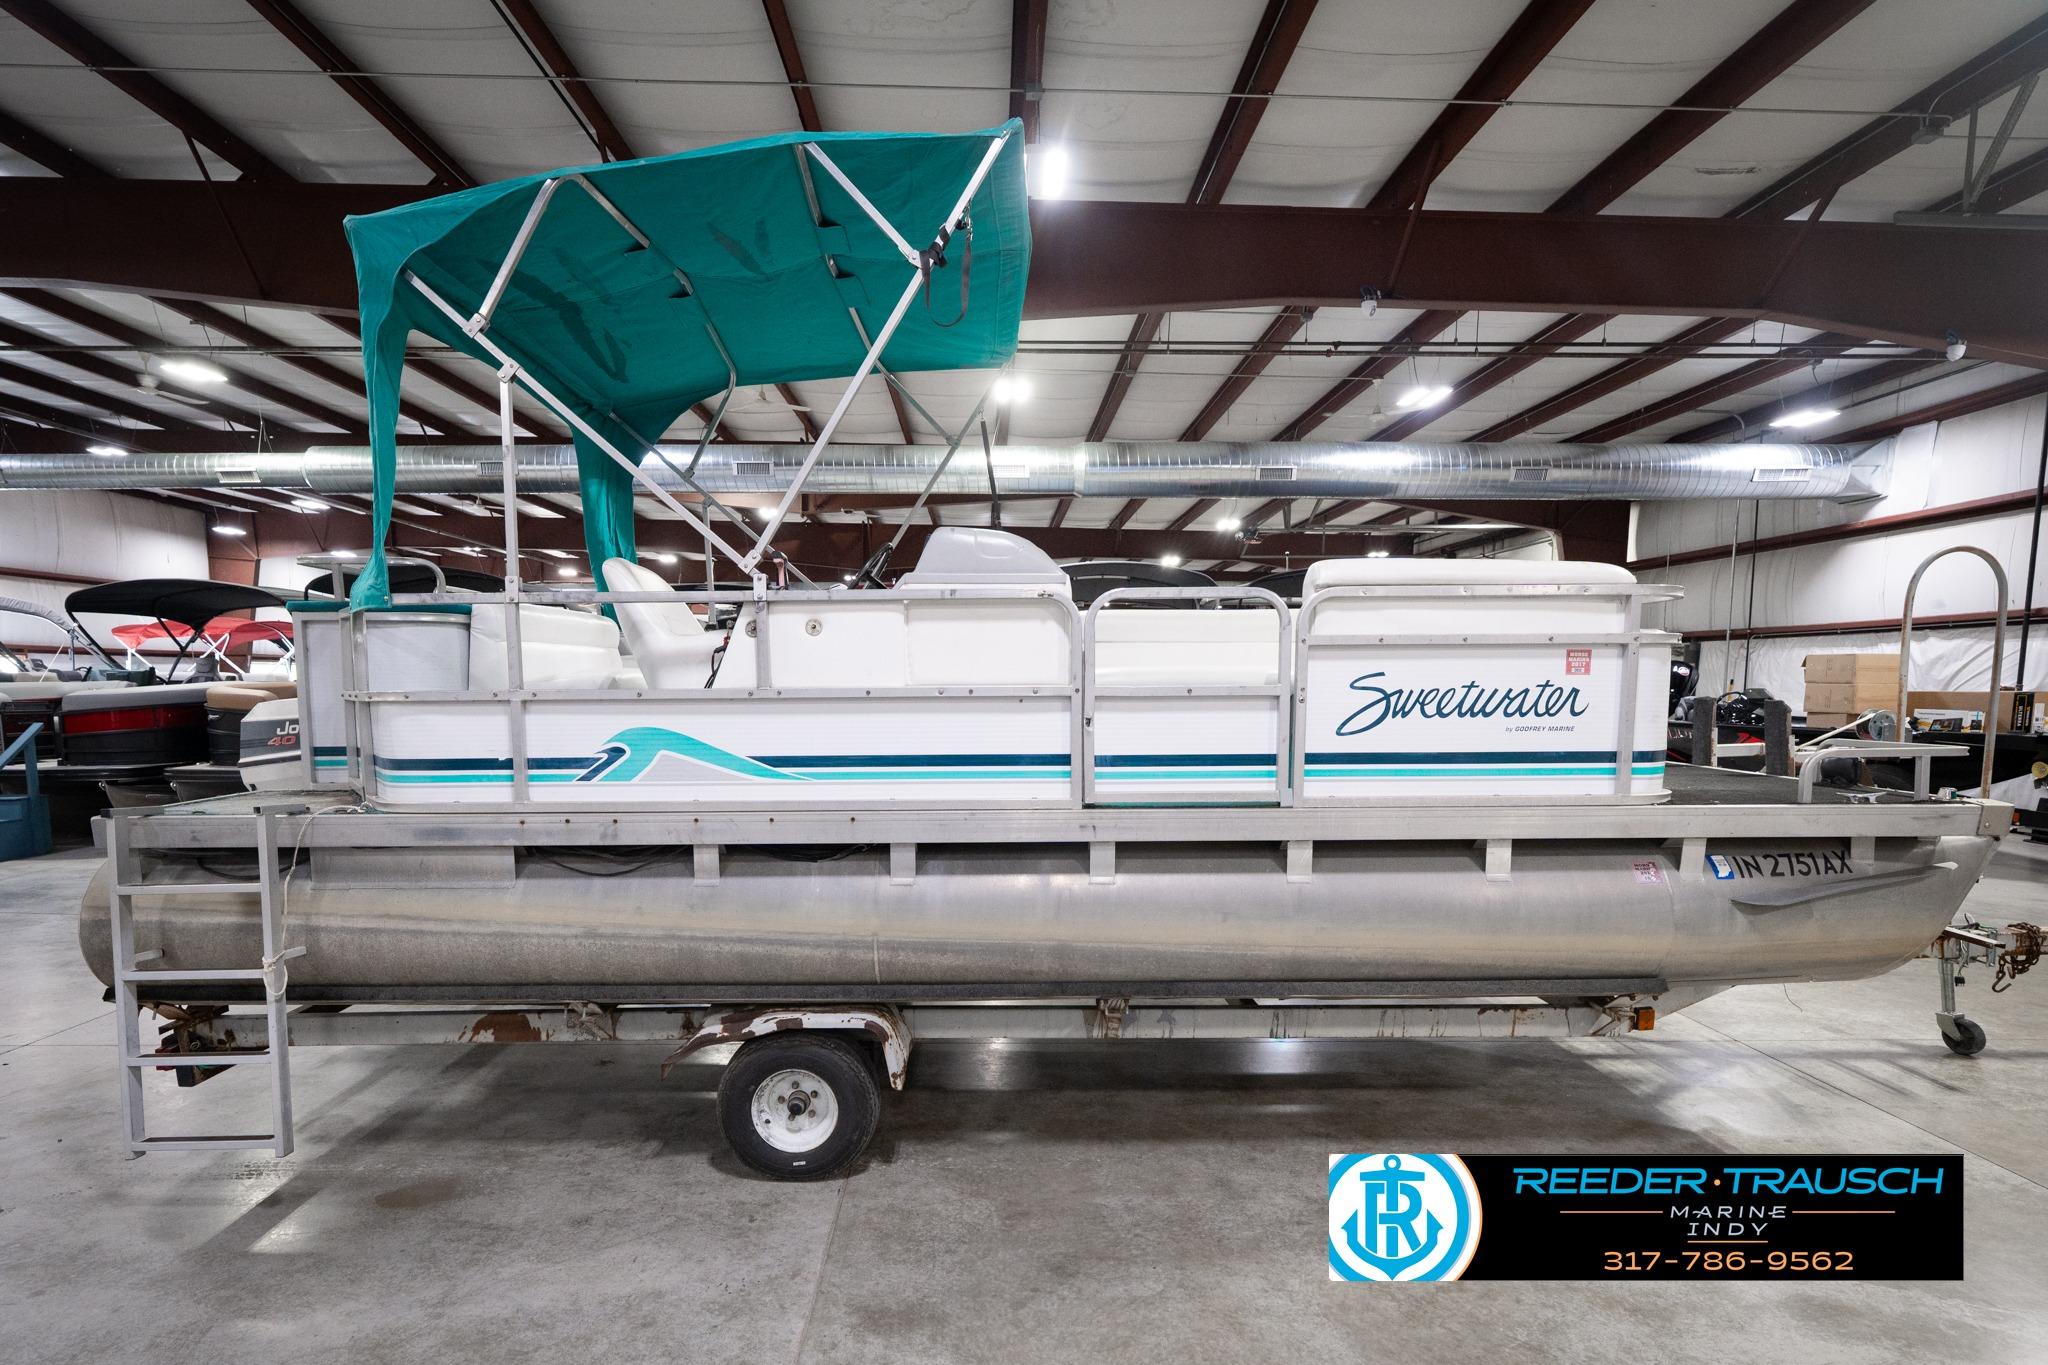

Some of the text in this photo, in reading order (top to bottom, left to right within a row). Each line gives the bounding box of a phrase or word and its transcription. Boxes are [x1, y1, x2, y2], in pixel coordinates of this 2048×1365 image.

[1335, 671, 1590, 737] Sweetwater
[267, 735, 297, 746] 40
[1732, 856, 1764, 879] IN
